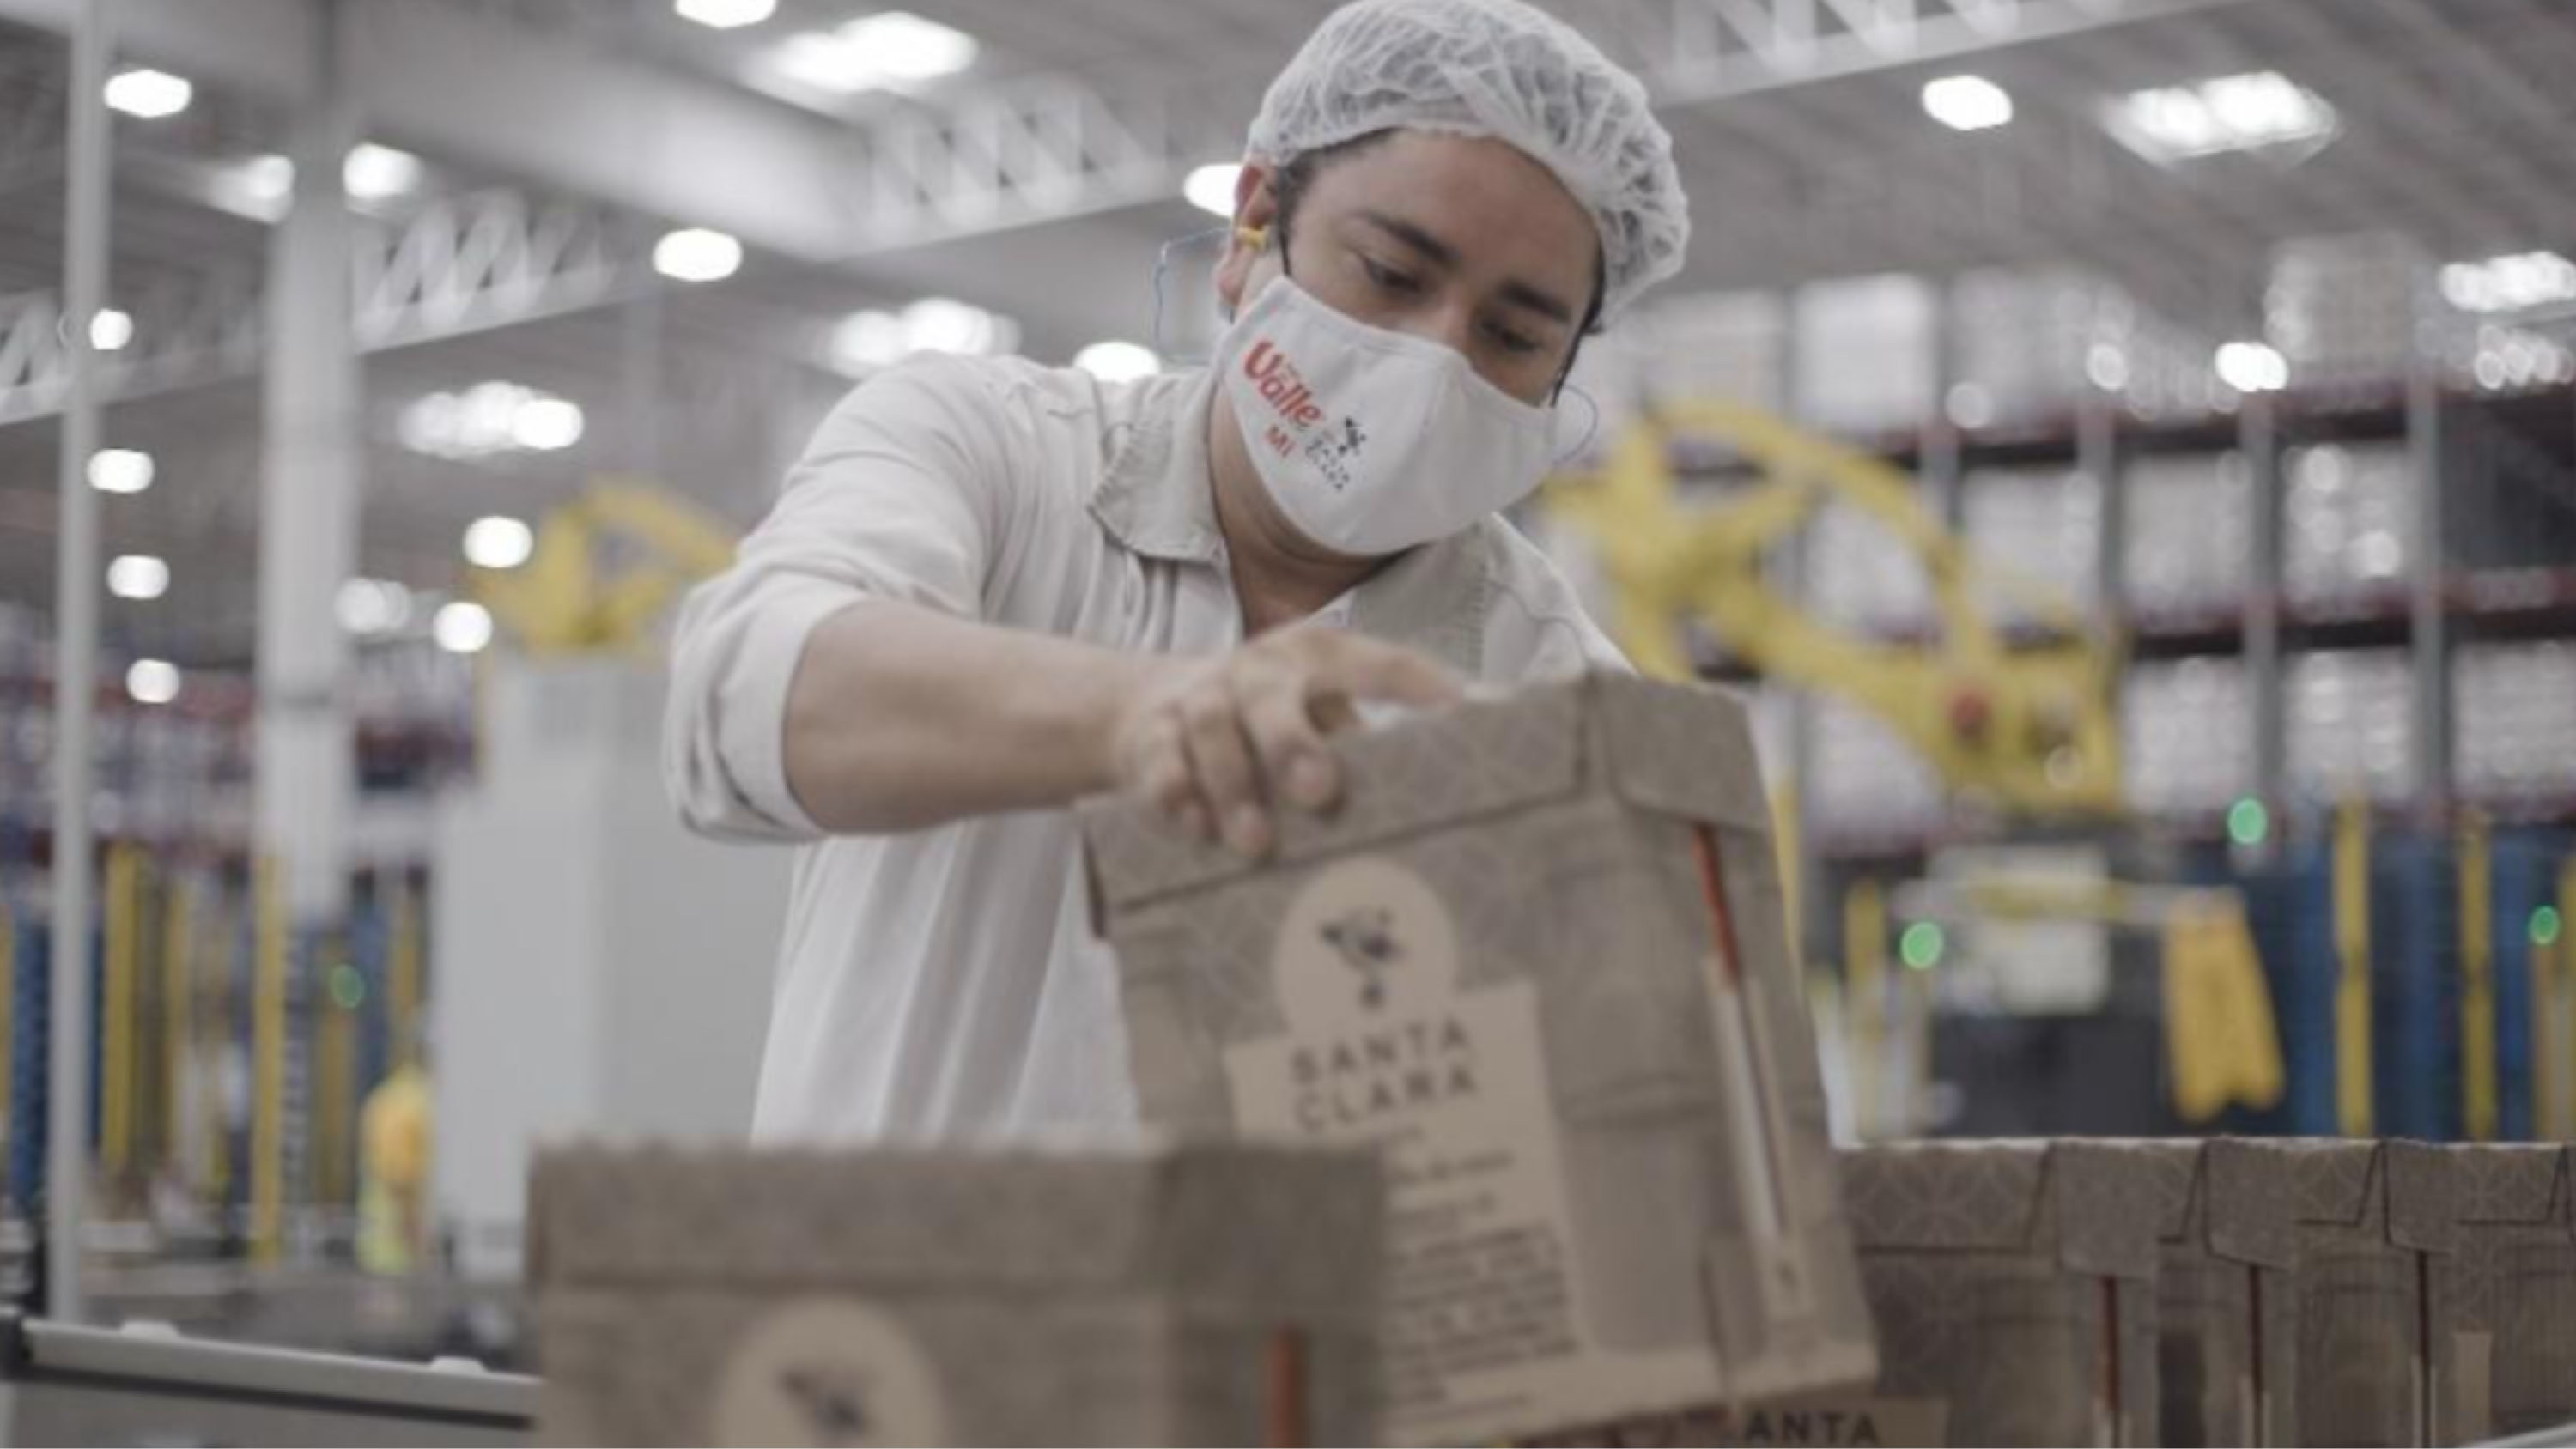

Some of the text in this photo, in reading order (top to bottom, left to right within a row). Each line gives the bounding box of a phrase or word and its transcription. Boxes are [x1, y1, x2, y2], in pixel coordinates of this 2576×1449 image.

[1288, 1012, 1471, 1087] SANTA
[1293, 1063, 1479, 1133] CLARA
[1741, 1408, 1880, 1445] ANTA
